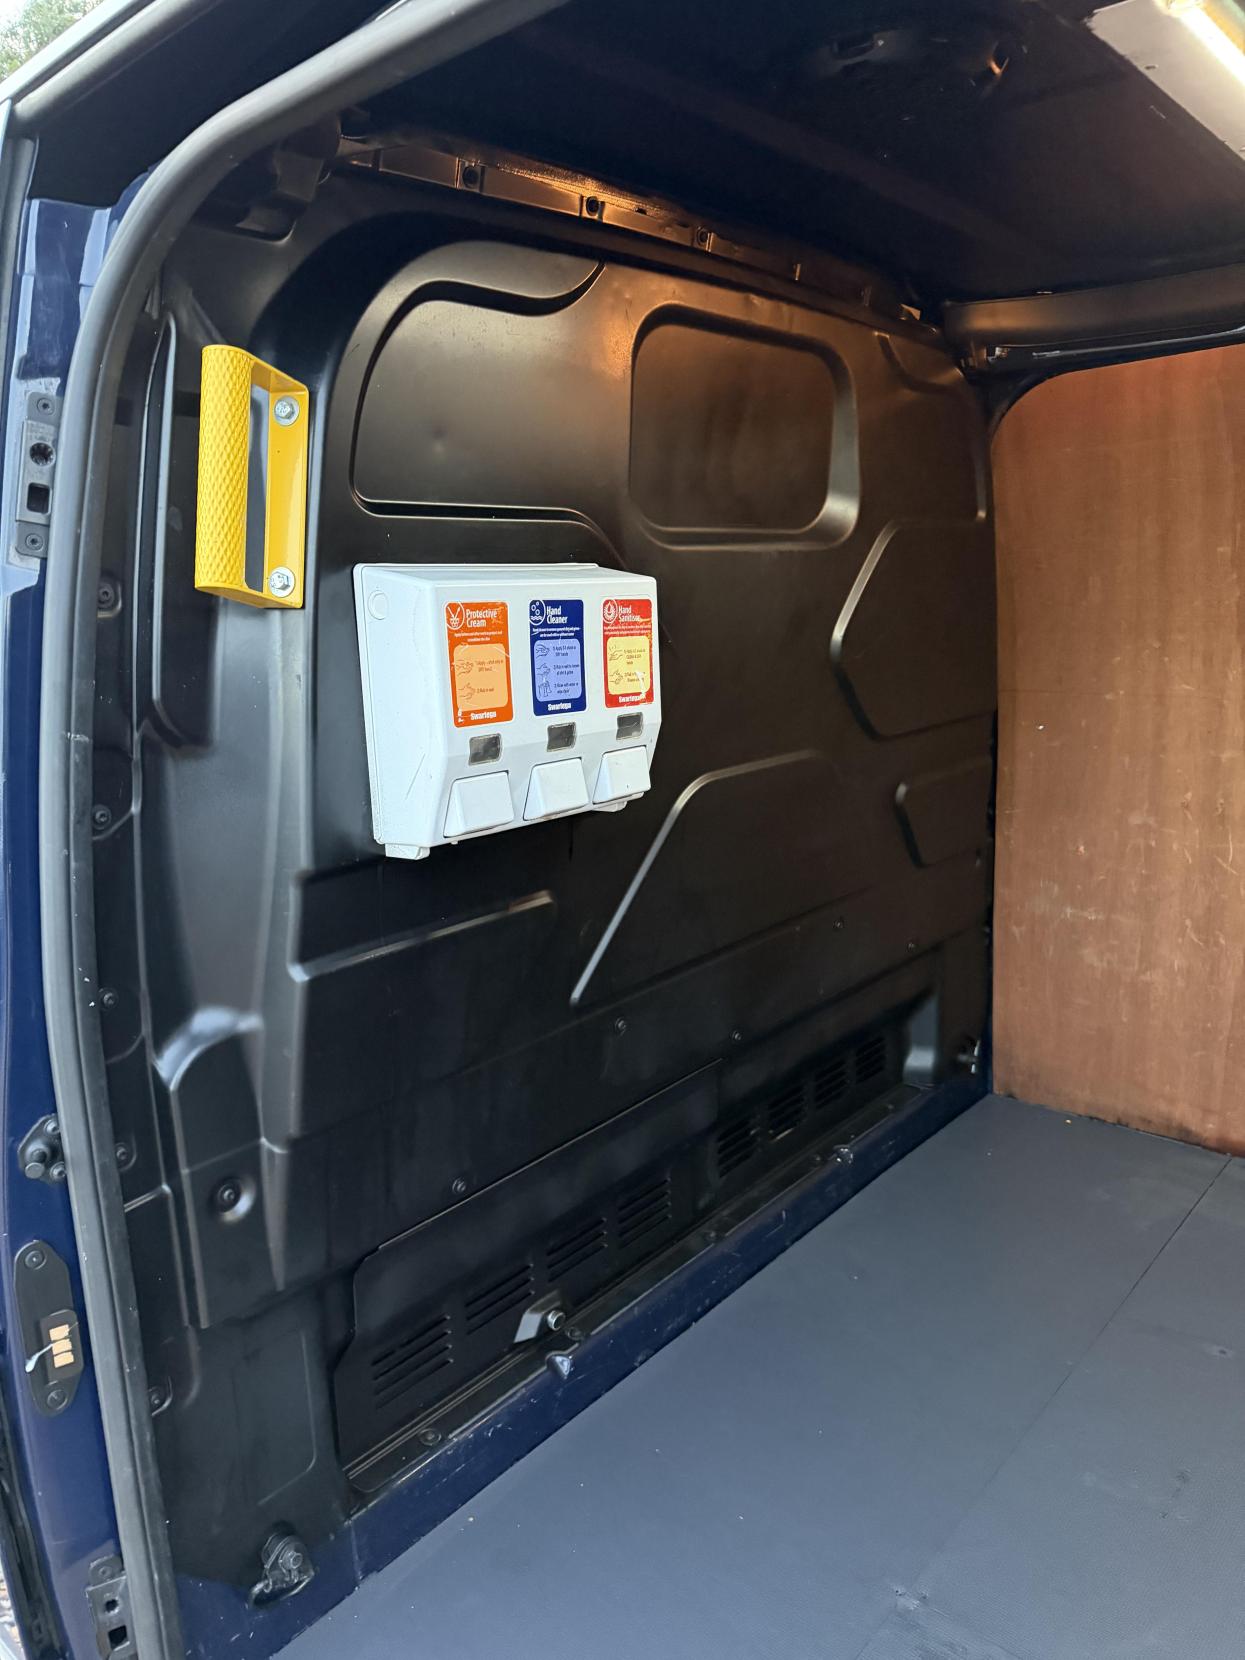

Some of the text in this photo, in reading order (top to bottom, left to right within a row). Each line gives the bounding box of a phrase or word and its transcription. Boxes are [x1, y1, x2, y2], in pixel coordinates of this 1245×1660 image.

[465, 608, 498, 619] Protective
[546, 605, 562, 615] Hand
[618, 604, 631, 614] Hand
[466, 618, 487, 627] Cream
[546, 615, 568, 624] Cleaner
